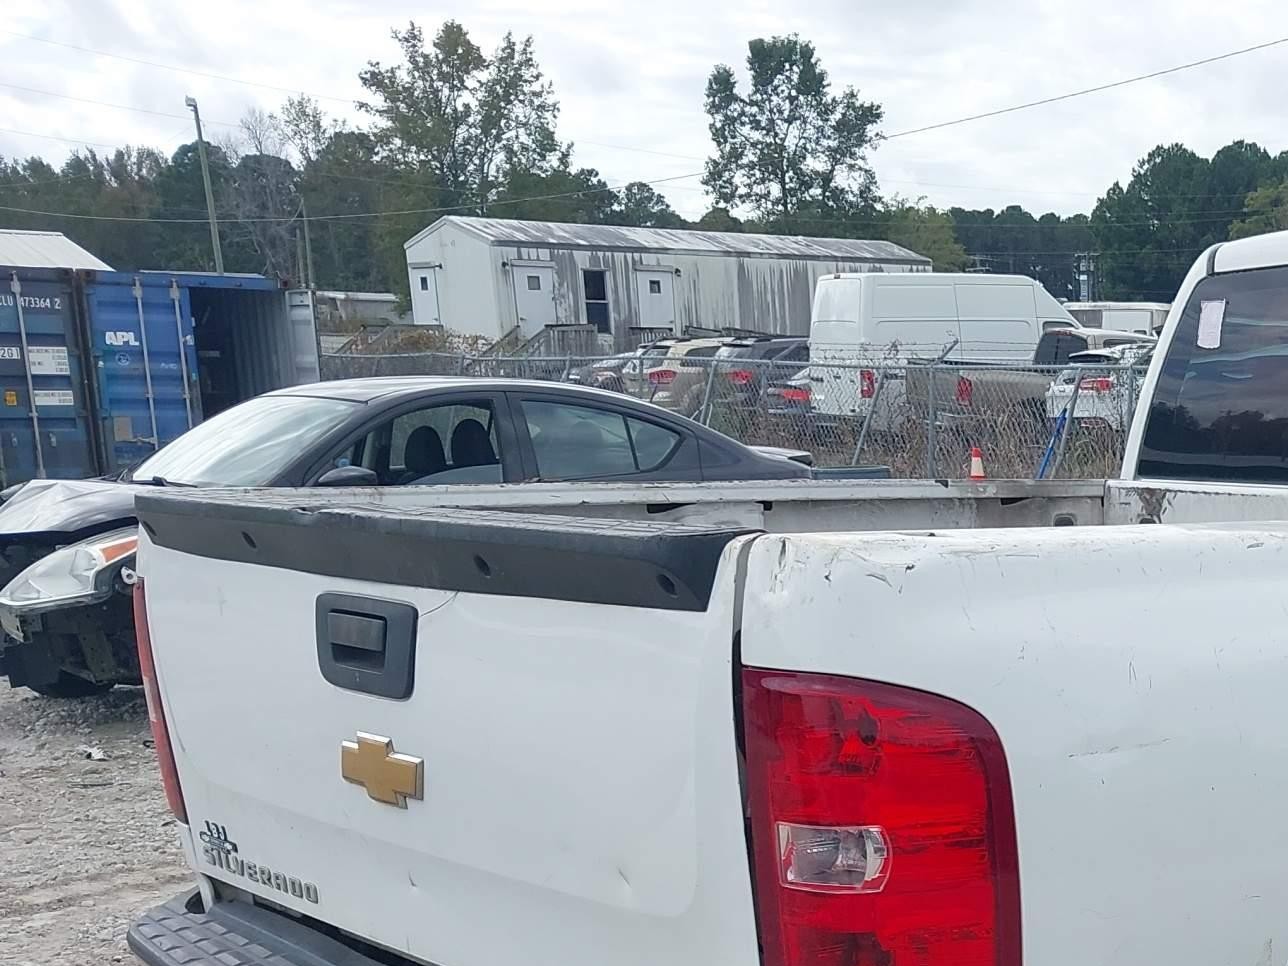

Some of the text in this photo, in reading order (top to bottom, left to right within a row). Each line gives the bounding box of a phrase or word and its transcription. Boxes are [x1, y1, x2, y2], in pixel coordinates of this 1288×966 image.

[54, 298, 61, 309] 2
[105, 331, 140, 346] APL
[202, 844, 319, 905] SILVERADO
